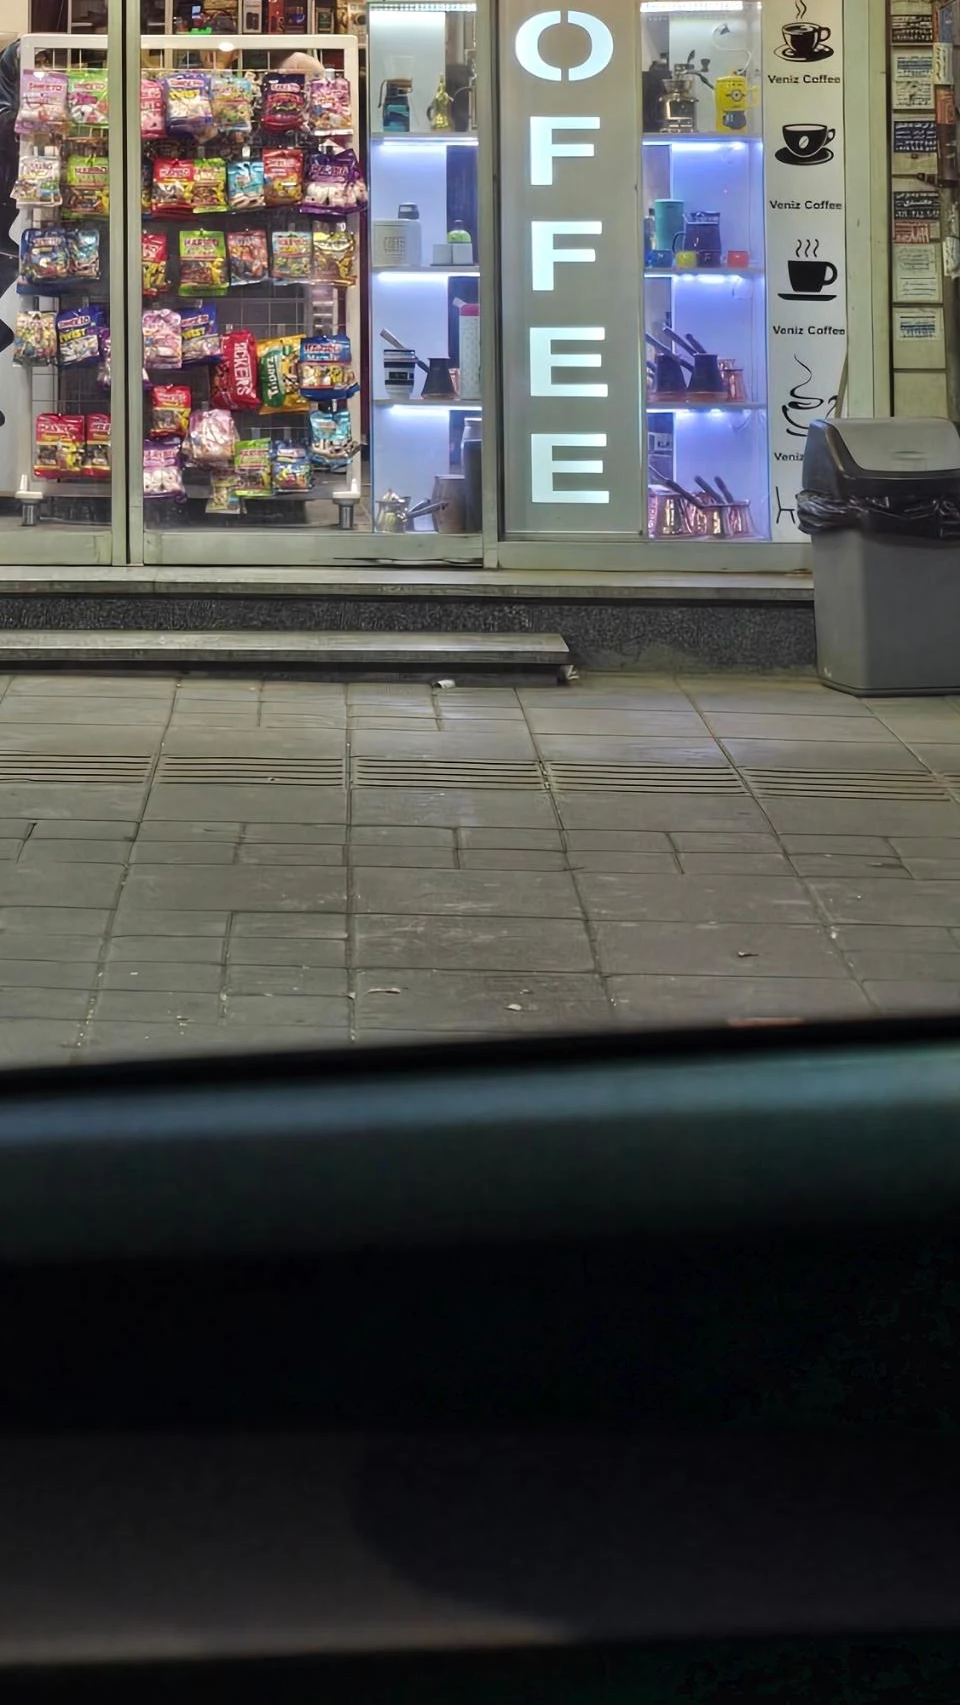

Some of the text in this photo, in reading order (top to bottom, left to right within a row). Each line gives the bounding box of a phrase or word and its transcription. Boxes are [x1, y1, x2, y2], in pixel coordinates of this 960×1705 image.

[768, 74, 841, 84] Veniz Coffee
[770, 200, 842, 210] Veniz Coffee
[772, 325, 845, 335] Veniz Coffee
[774, 452, 804, 462] Veniz
